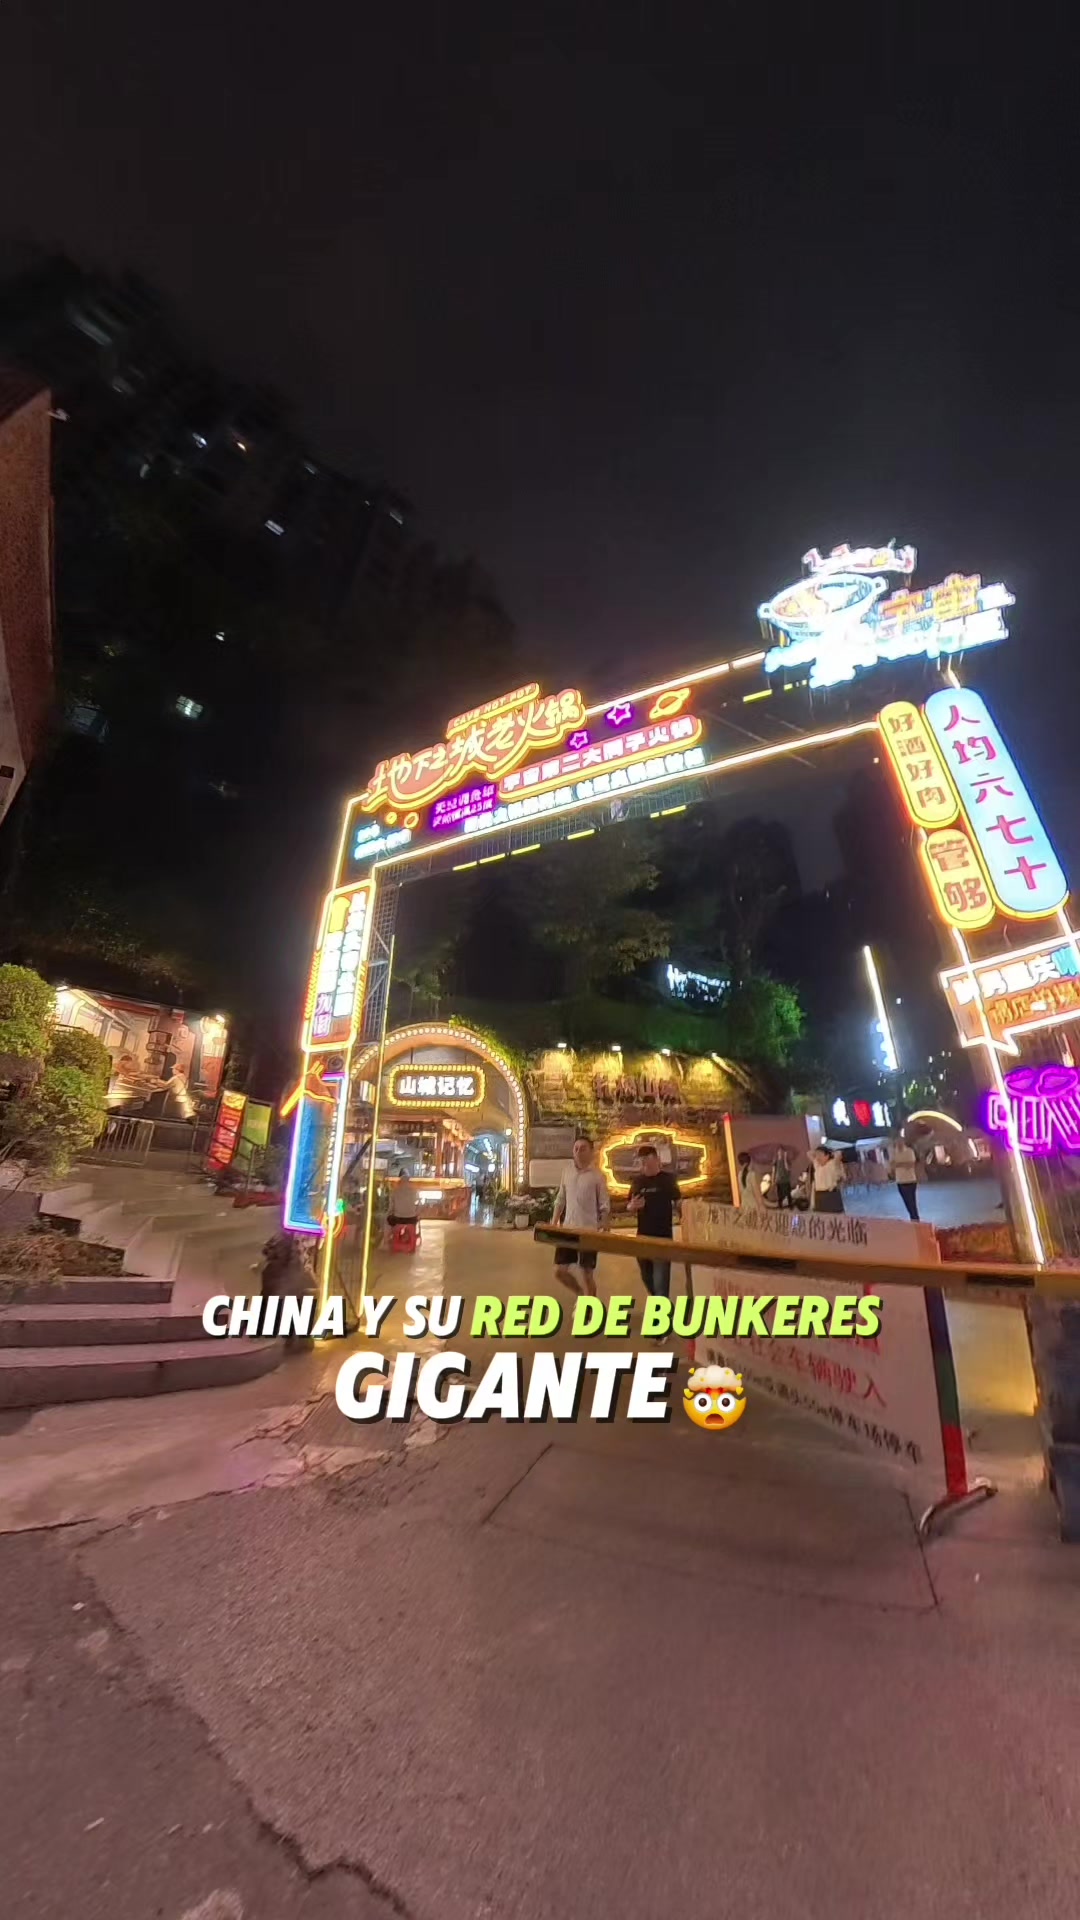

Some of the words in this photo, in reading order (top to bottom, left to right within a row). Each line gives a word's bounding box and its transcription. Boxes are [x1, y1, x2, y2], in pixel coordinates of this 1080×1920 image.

[371, 690, 581, 800] 地下之城老火锅
[453, 708, 481, 727] CAVE
[888, 712, 946, 808] 好酒好肉
[943, 704, 1048, 891] 人均六七十
[928, 838, 988, 913] 管够
[399, 1075, 475, 1097] 山城记忆
